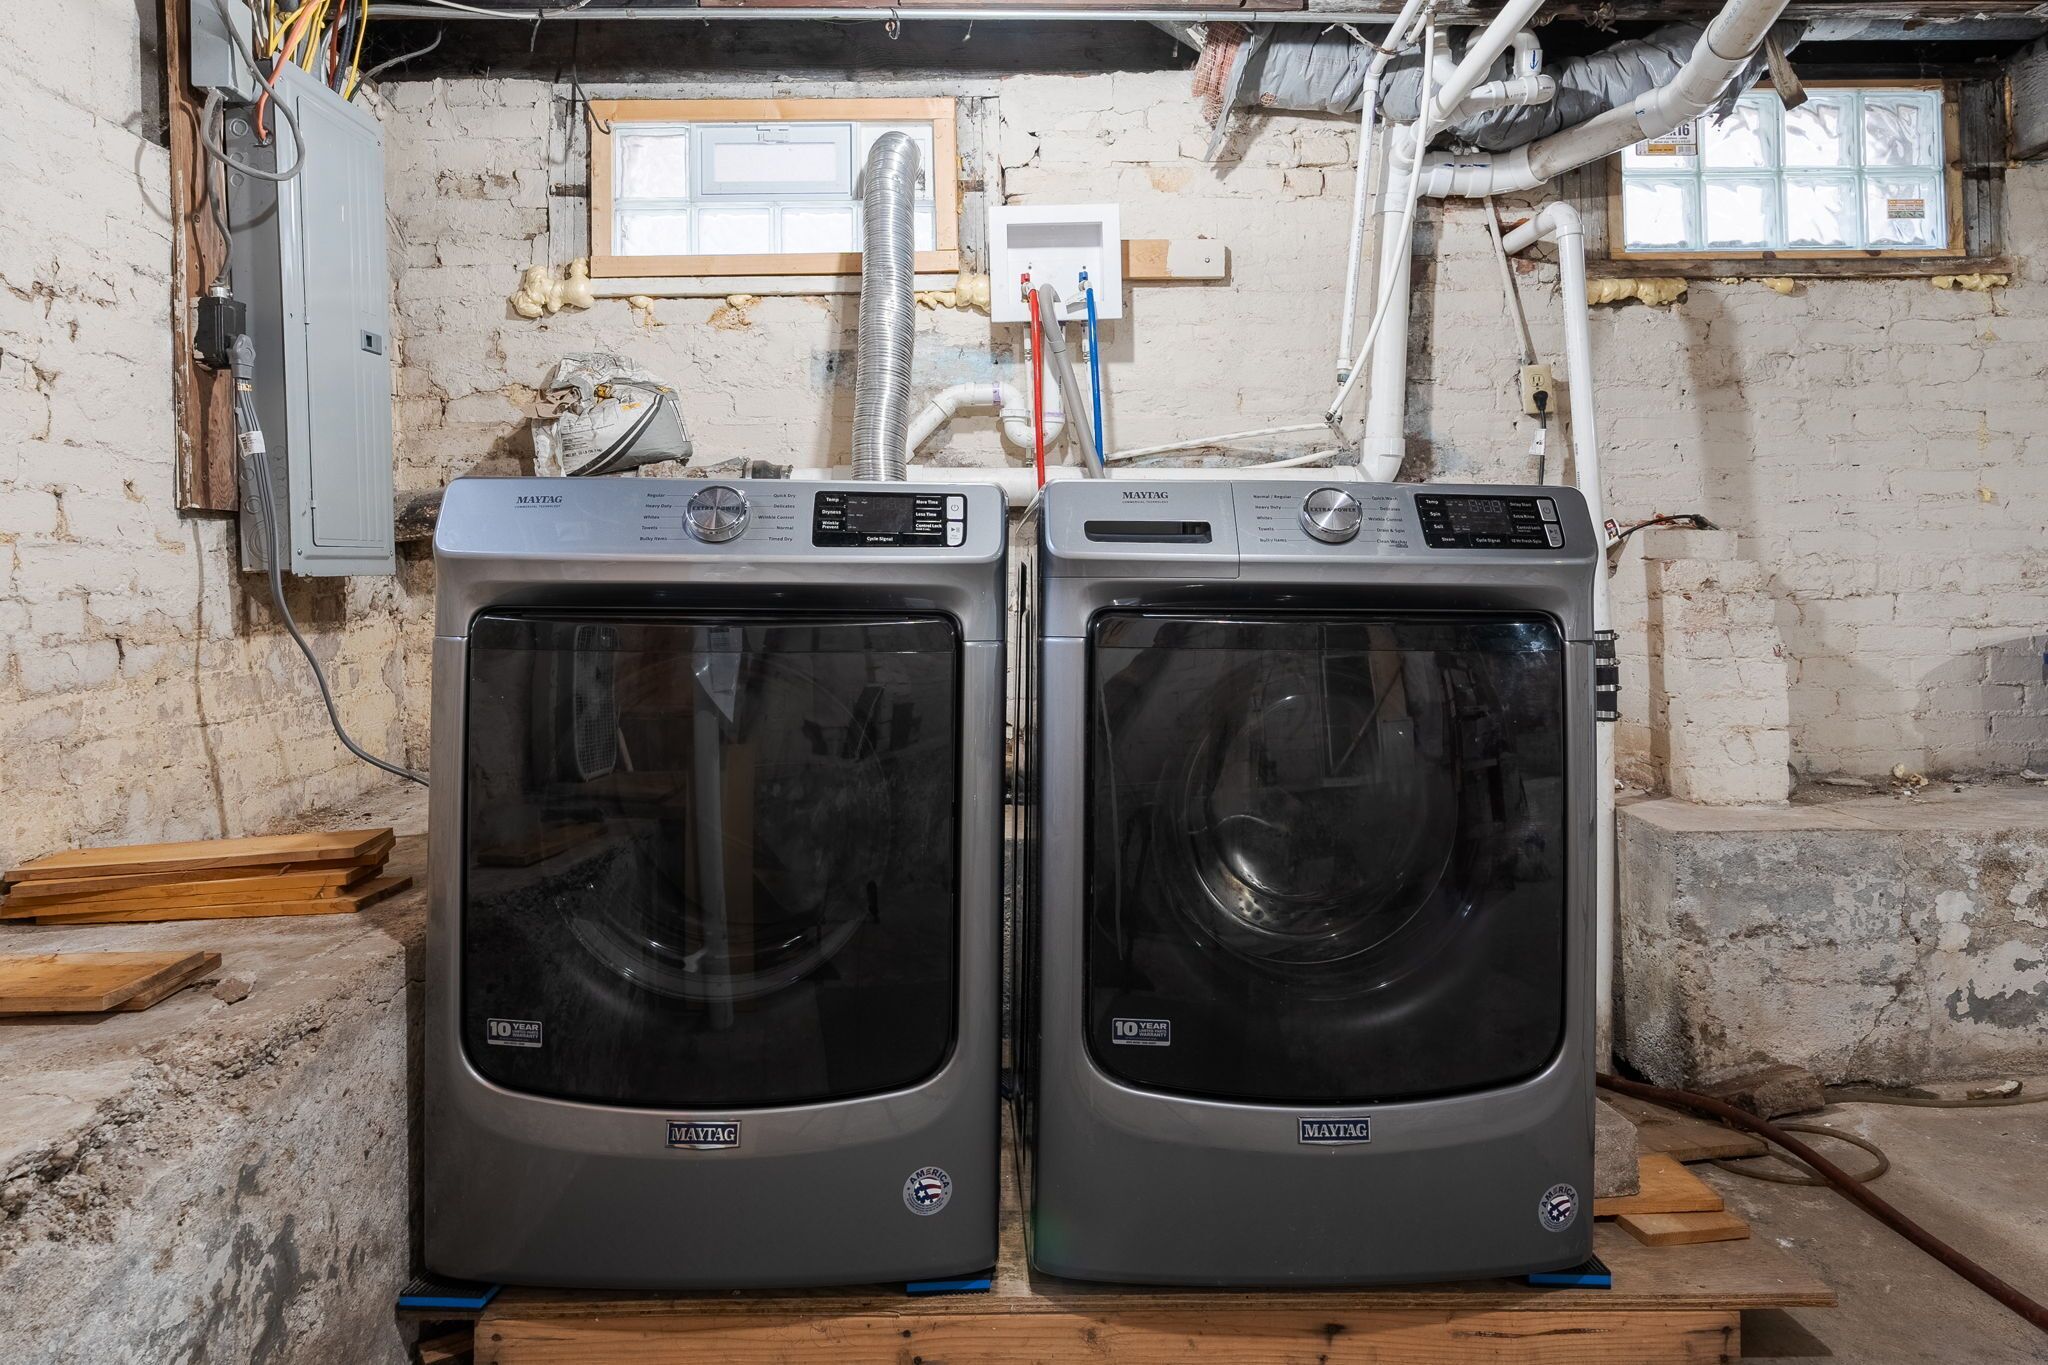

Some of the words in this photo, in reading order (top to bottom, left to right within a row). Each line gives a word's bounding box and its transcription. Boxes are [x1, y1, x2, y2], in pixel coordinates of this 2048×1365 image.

[516, 495, 563, 504] MAYTAG
[1122, 491, 1169, 499] MAYTAG
[490, 1021, 511, 1037] 10
[512, 1023, 539, 1031] YEAR
[1115, 1021, 1138, 1036] 10
[1139, 1022, 1167, 1030] YEAR
[671, 1127, 735, 1141] MAYTAG
[1303, 1123, 1367, 1138] MAYTAG
[909, 1167, 950, 1189] AMERICA
[1541, 1186, 1576, 1208] AMERICA
